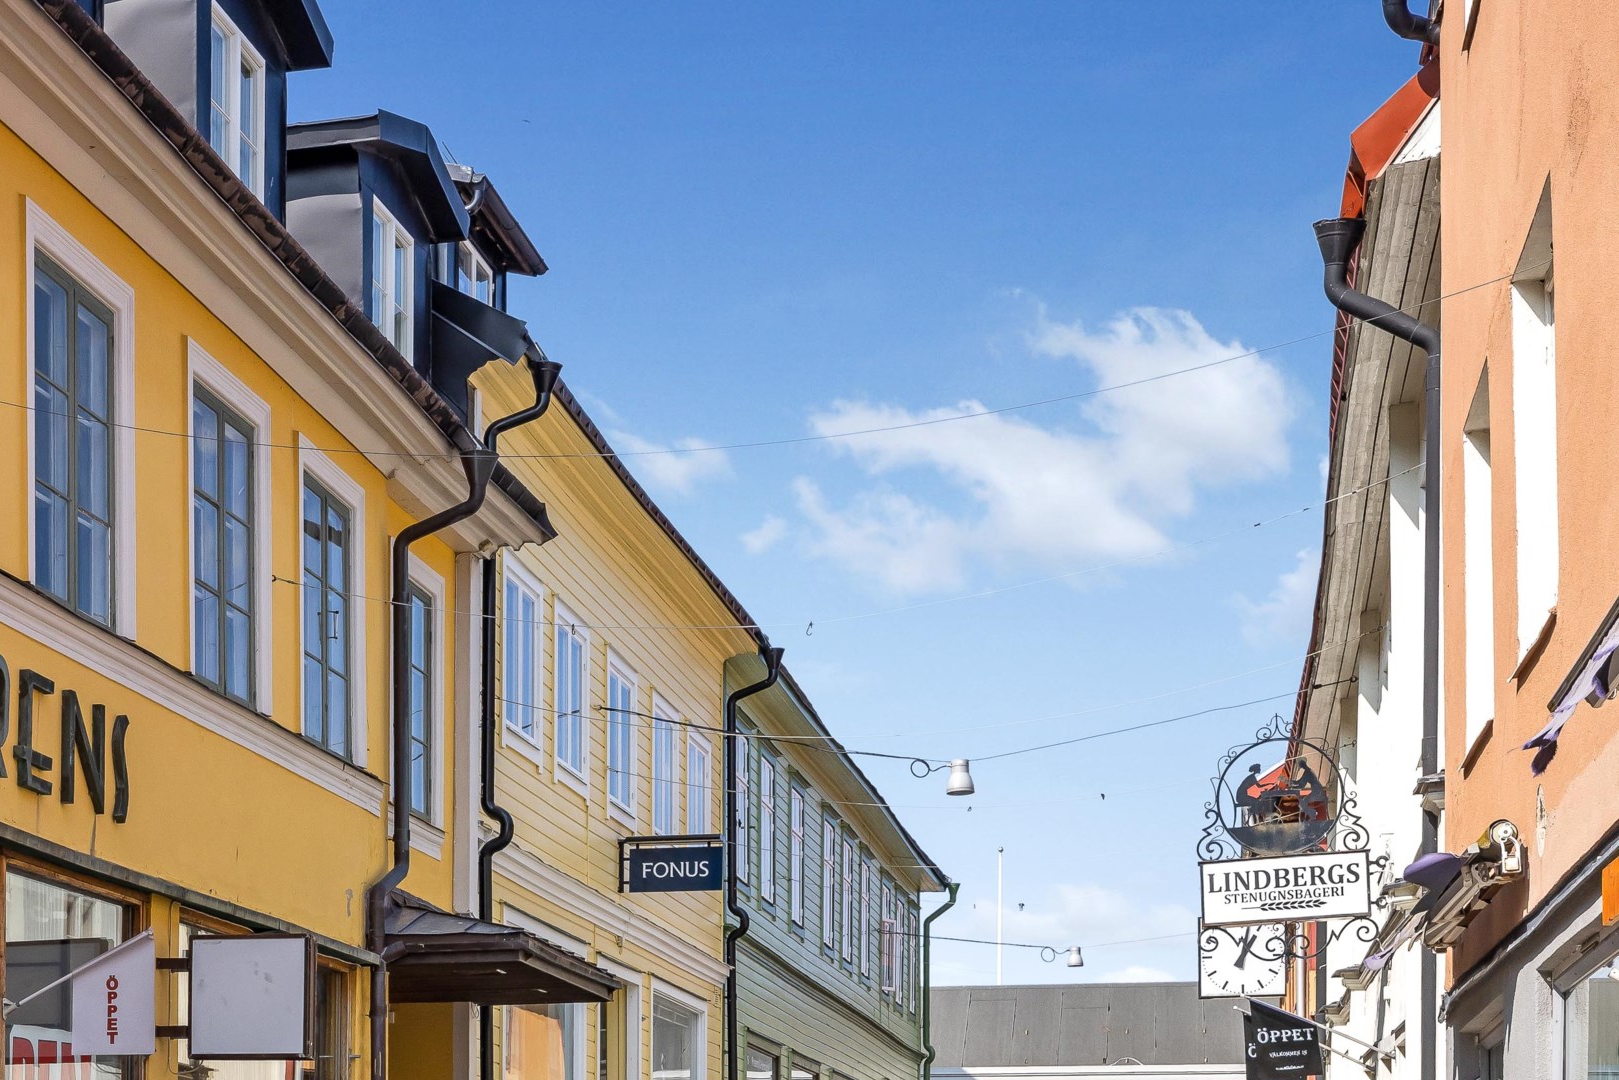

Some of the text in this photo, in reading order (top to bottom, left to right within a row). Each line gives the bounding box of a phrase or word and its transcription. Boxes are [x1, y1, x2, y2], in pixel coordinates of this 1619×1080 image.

[642, 861, 710, 878] FONUS
[1208, 863, 1360, 893] LINDBERGS
[1224, 886, 1345, 905] STENUGNSBAGERI
[106, 974, 119, 1045] ÖPPET
[1257, 1028, 1314, 1043] ÖPPET
